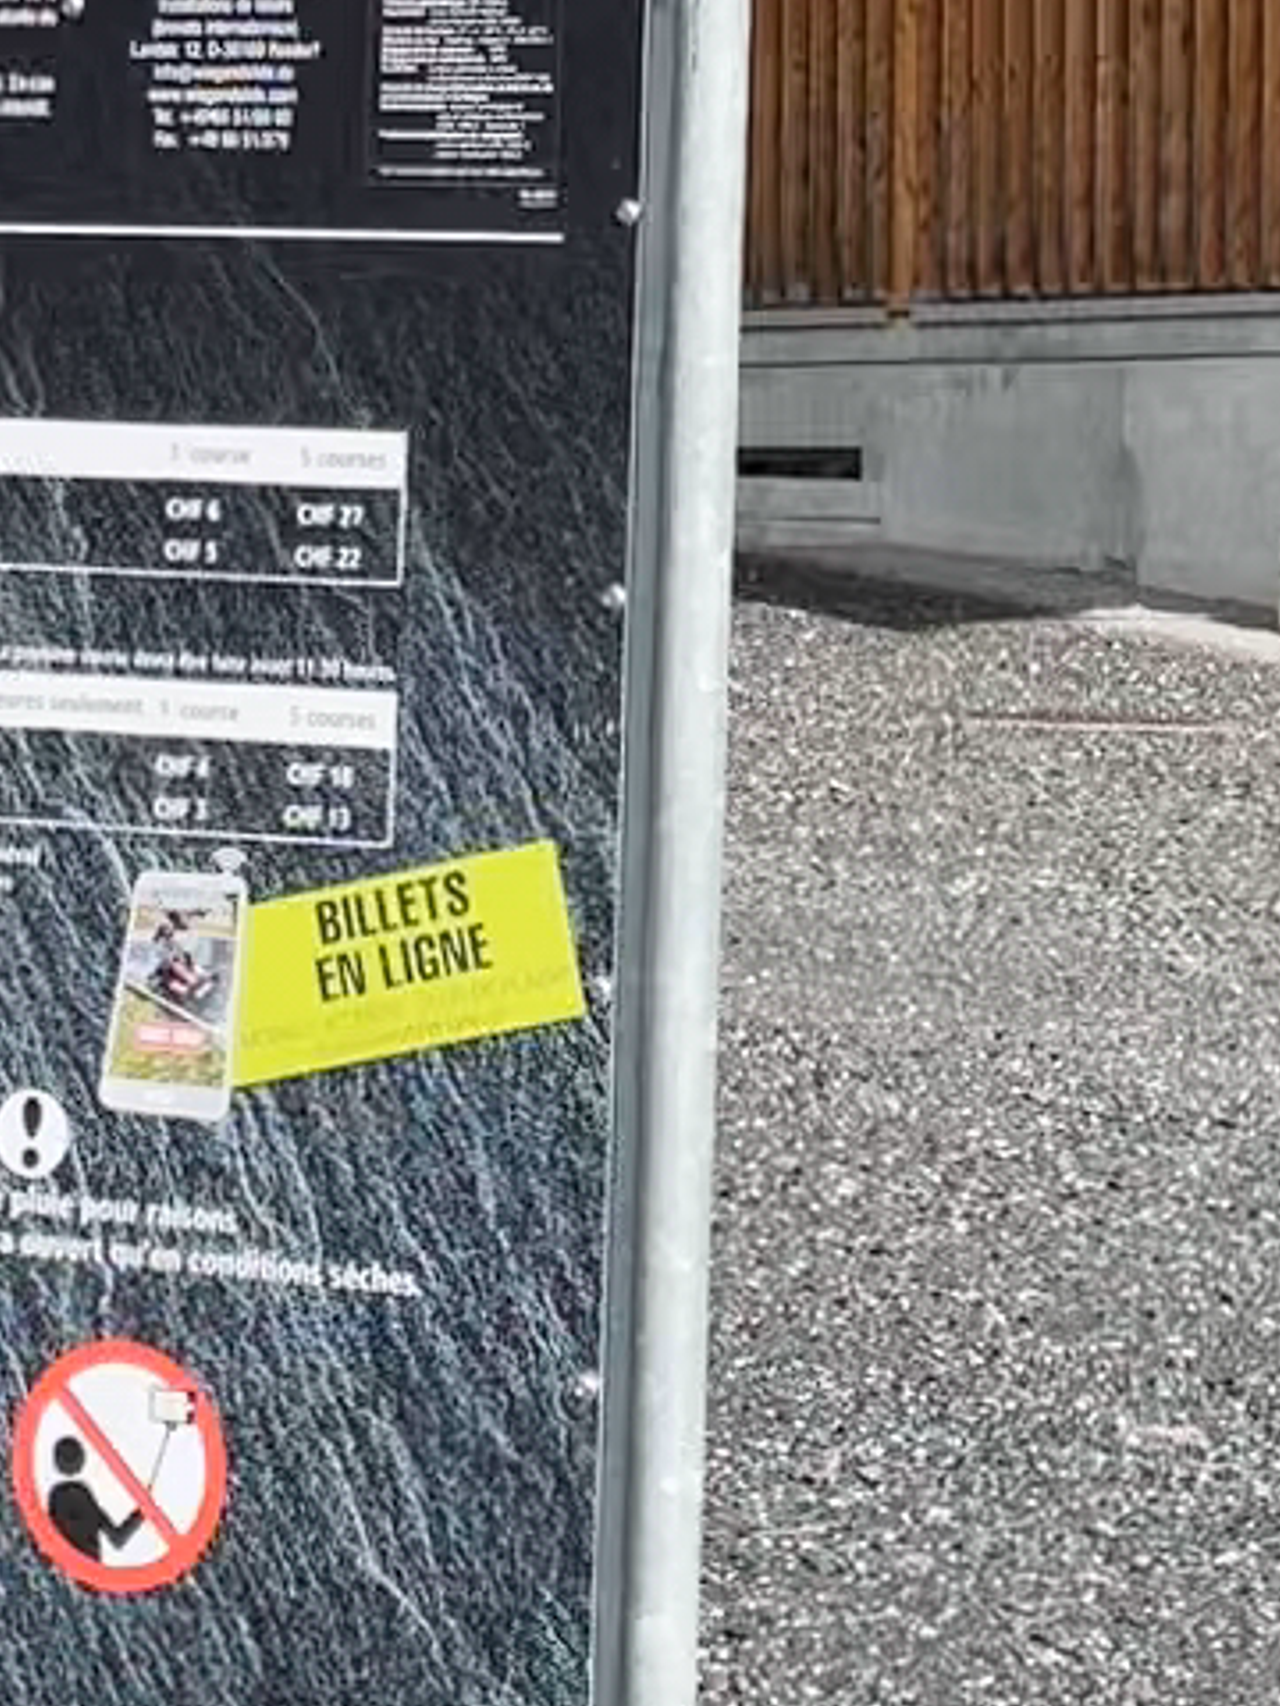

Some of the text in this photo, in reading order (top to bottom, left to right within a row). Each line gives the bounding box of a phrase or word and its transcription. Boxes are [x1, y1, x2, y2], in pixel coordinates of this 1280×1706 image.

[164, 497, 203, 522] CHF
[295, 503, 336, 527] CHF
[163, 538, 201, 562] CHF
[293, 544, 334, 569] CHF
[336, 546, 363, 570] 22
[155, 754, 194, 778] CHF
[287, 761, 326, 787] CHF
[152, 794, 191, 821] CHF
[282, 803, 323, 830] CHF
[315, 869, 470, 946] BILLETS
[315, 923, 493, 1004] EN LIGNE
